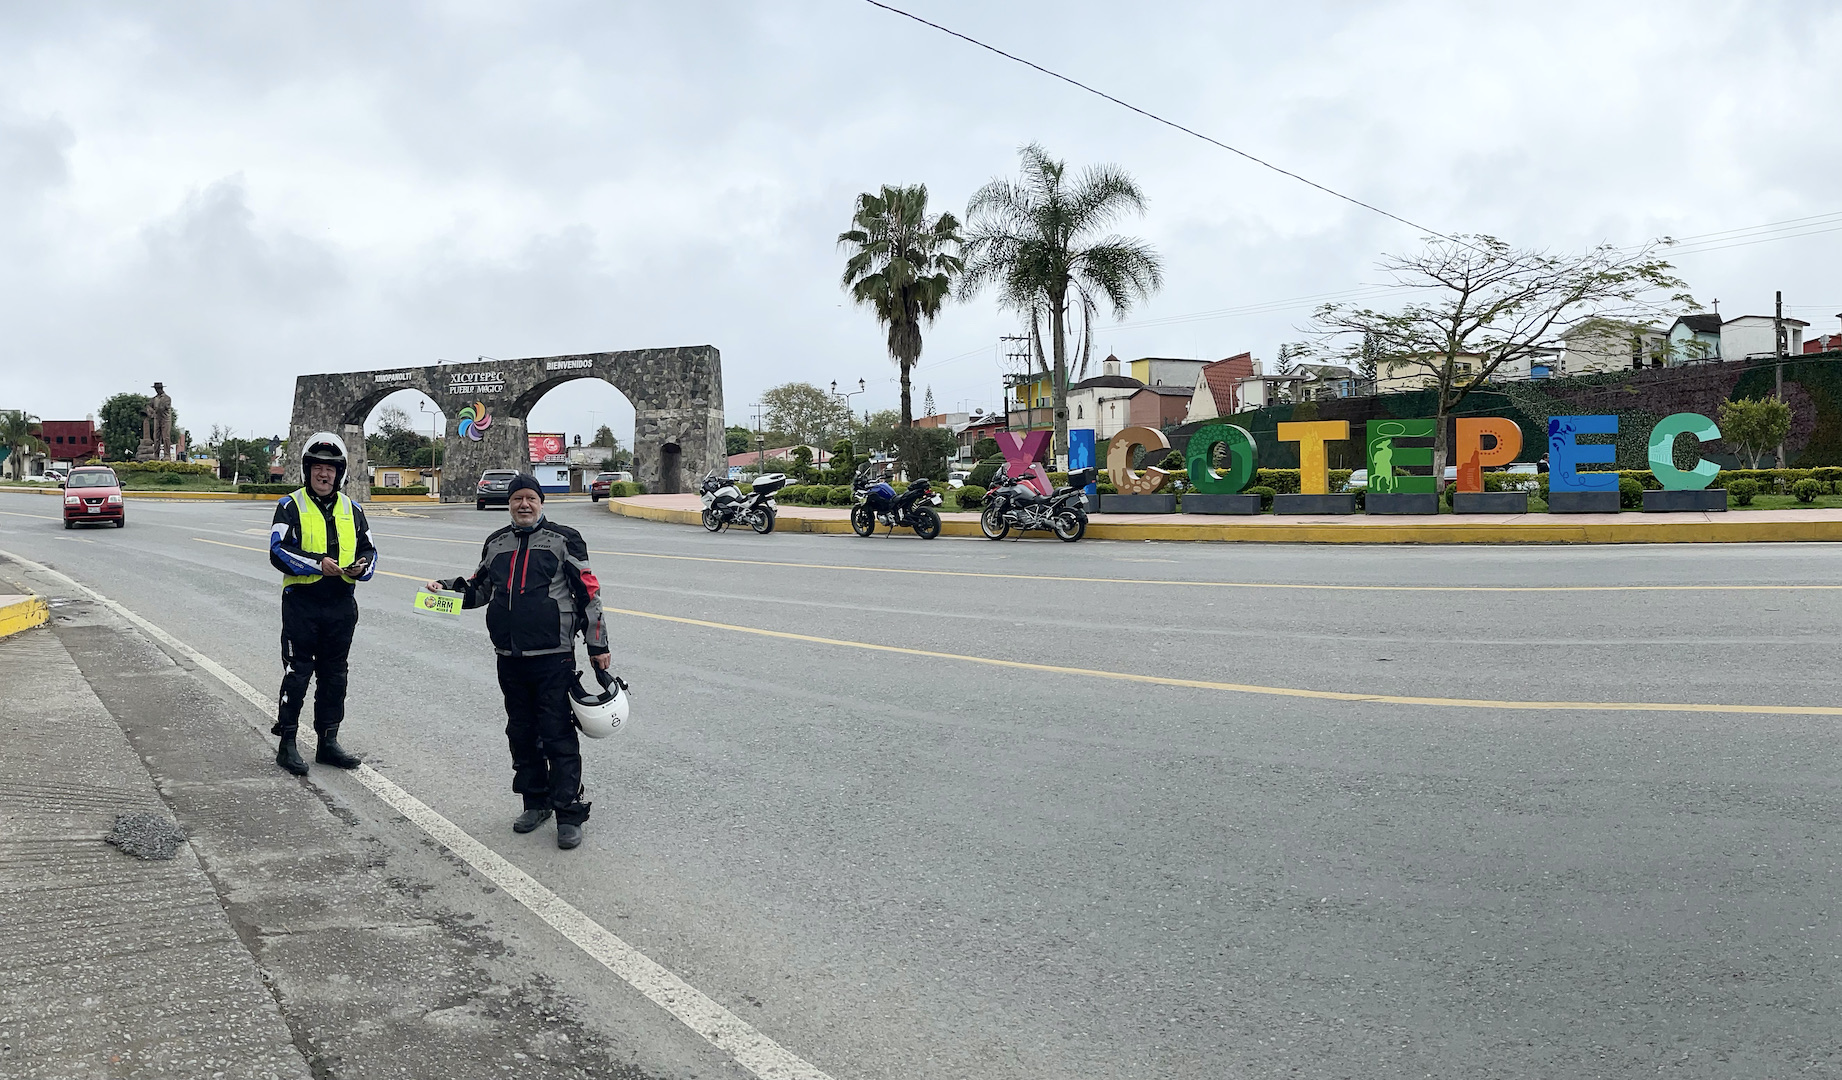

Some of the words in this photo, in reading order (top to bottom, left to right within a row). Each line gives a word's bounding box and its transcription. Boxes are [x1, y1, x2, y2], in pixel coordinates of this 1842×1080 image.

[546, 359, 593, 370] BIENVENIDOS
[449, 386, 474, 394] PUEBLO
[994, 412, 1722, 492] XICOTEPEC
[436, 599, 453, 609] RRM
